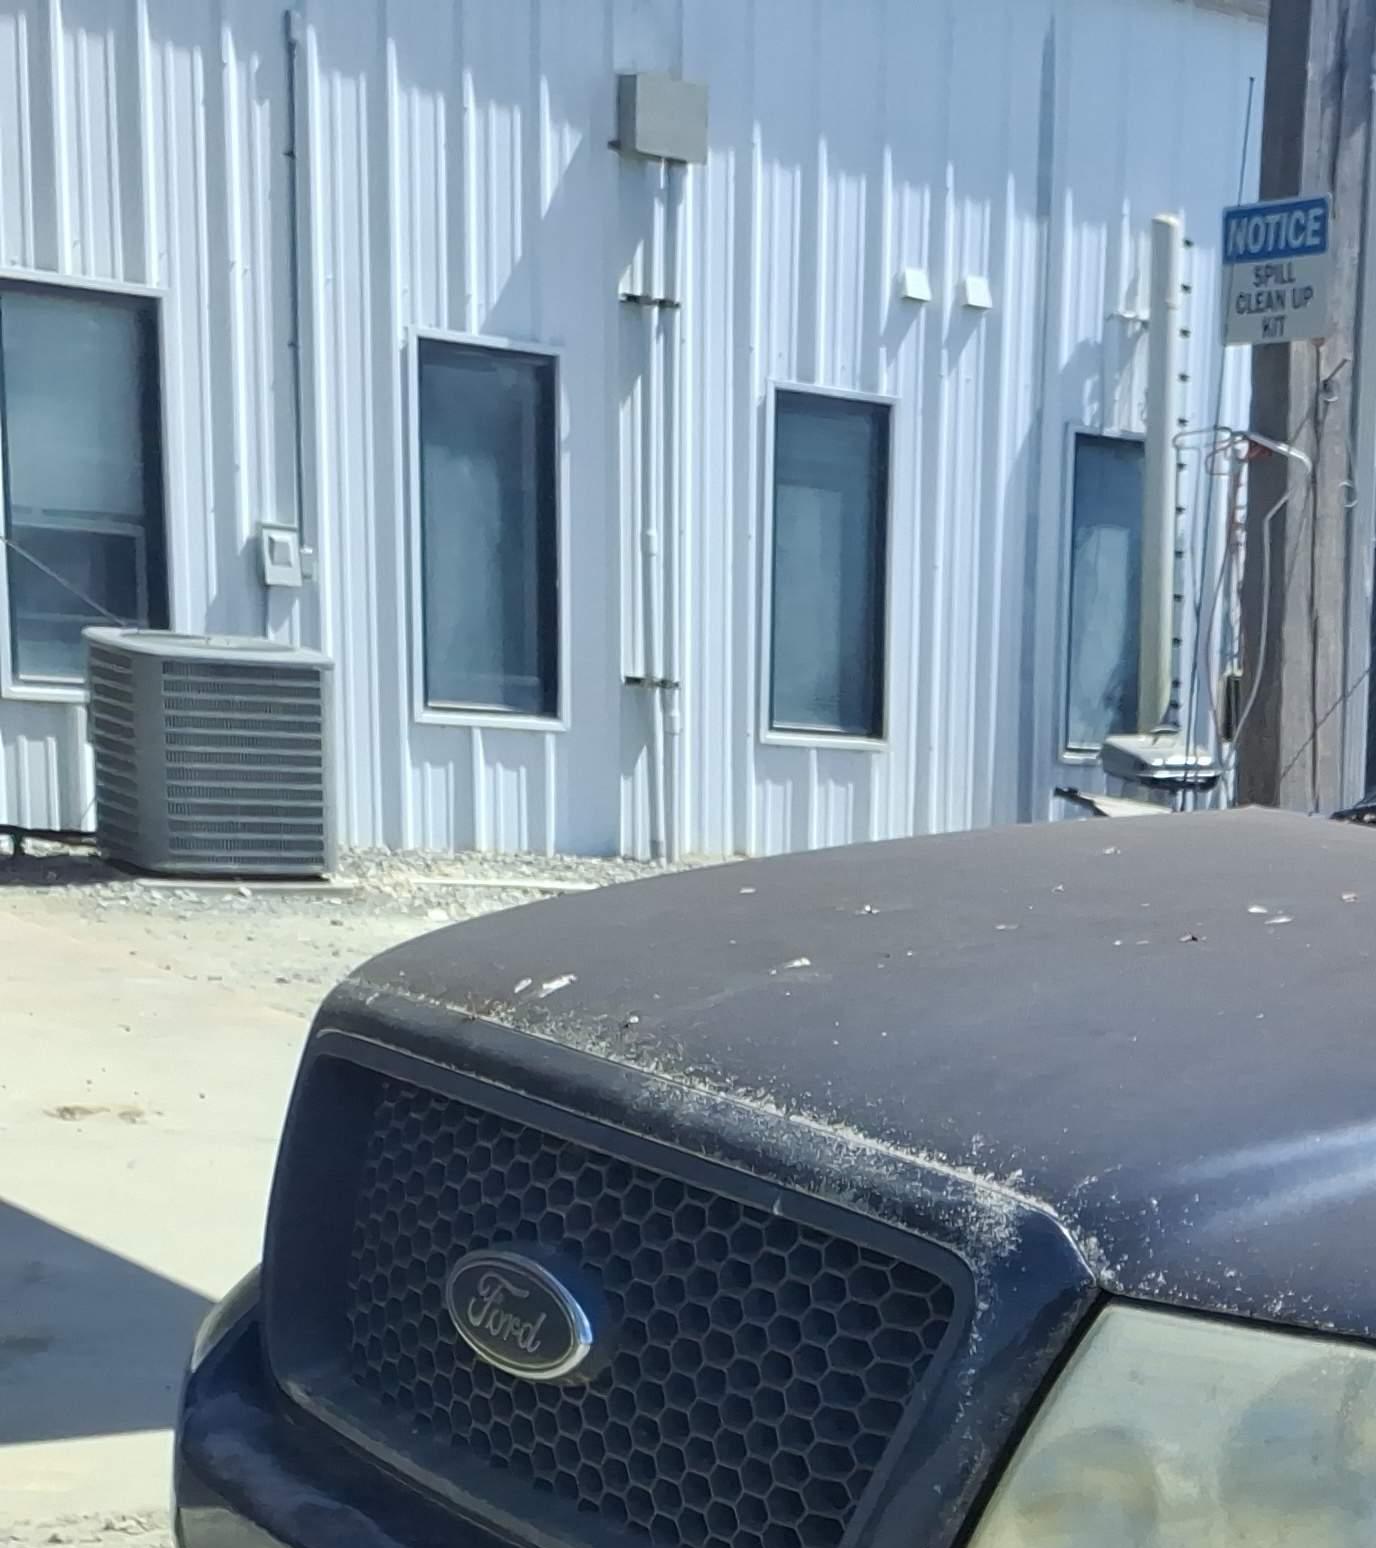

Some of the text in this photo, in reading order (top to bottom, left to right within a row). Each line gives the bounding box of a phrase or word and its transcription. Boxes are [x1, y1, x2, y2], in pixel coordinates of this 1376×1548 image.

[1227, 207, 1324, 256] NOTICE
[1253, 262, 1296, 287] SPILL
[1235, 286, 1314, 314] CLEAN UP
[1261, 316, 1287, 338] KIT
[468, 1271, 546, 1353] Ford
